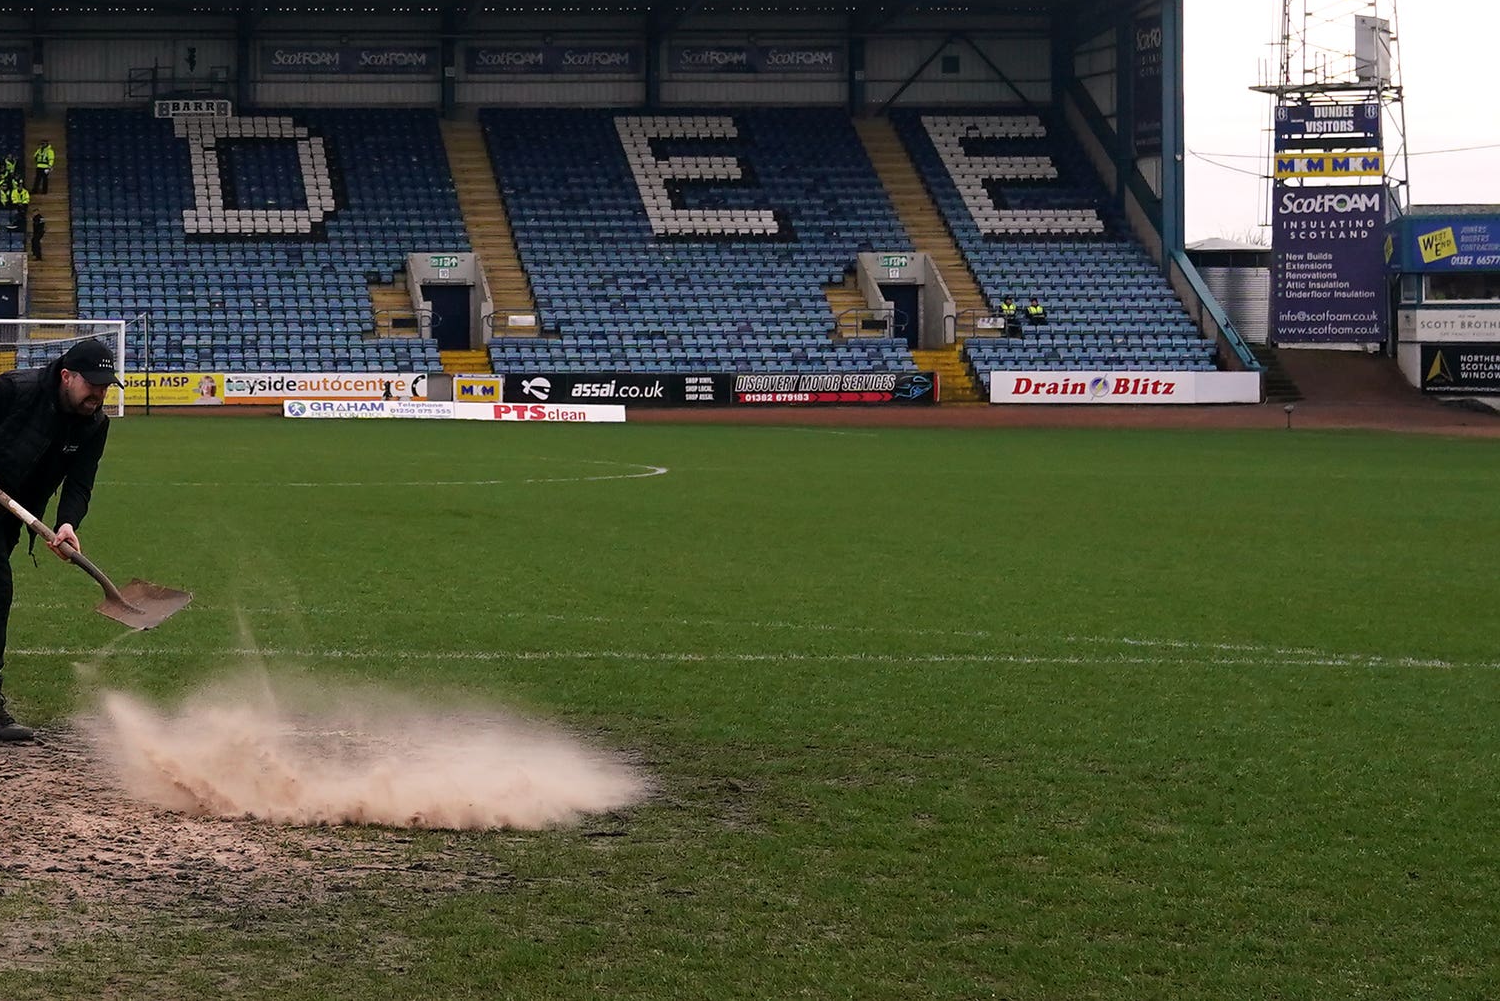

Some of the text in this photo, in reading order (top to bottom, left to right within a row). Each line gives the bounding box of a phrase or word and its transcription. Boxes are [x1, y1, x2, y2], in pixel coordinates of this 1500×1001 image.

[272, 50, 339, 65] ScotFOAM
[359, 50, 426, 65] ScotFOAM
[476, 51, 543, 66] ScotFOAM
[563, 51, 629, 66] ScotFOAM
[680, 50, 746, 65] ScotFOAM
[766, 50, 832, 65] ScotFOAM
[172, 102, 215, 111] BARR
[1314, 106, 1354, 118] DUNDEE
[1305, 120, 1354, 133] VISITORS
[1277, 157, 1325, 172] MKM
[1332, 156, 1380, 172] MKM
[1279, 193, 1380, 214] ScotFOAM
[1283, 219, 1375, 229] INSULATING
[1290, 230, 1368, 239] SCOTLAND
[1306, 252, 1333, 260] Builds
[1285, 262, 1333, 270] Extensions
[1285, 281, 1350, 289] Attic Insulation
[1279, 310, 1378, 322] info@scotfoam.co.uk
[1278, 323, 1380, 335] www.scotfoam.co.uk
[1420, 320, 1456, 329] SCOTT
[159, 376, 190, 388] MSP
[735, 374, 896, 392] DISCOVERY MOTOR SERVICES
[1012, 377, 1176, 395] Drain Blitz
[461, 385, 494, 396] MKM
[571, 380, 664, 397] assai.co.uk
[745, 393, 773, 402] 01382
[310, 402, 385, 412] GRAHAM
